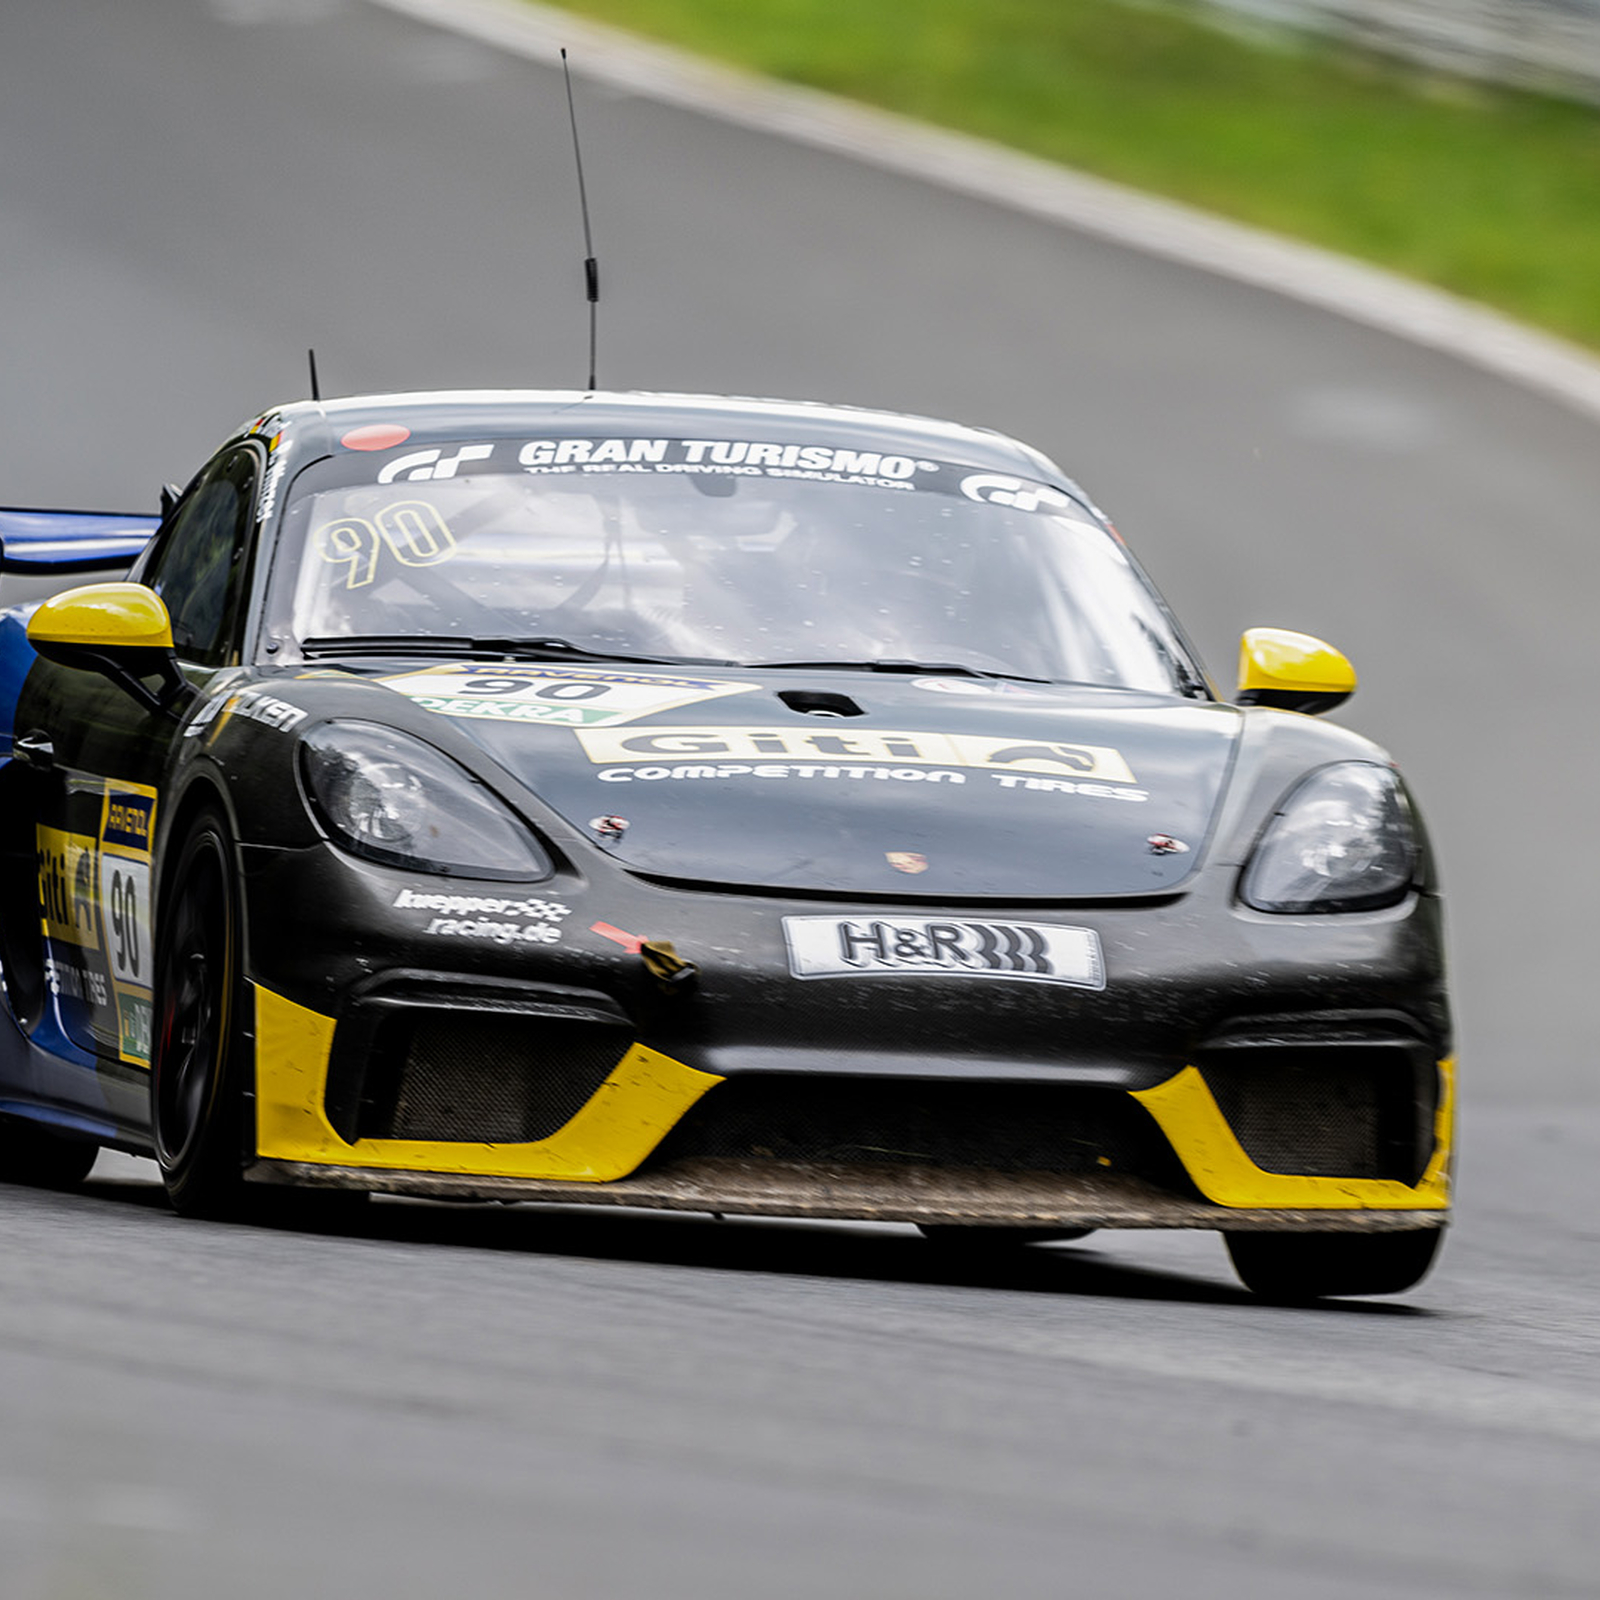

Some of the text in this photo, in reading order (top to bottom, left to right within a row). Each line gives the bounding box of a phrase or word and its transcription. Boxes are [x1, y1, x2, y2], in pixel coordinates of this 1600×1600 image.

[518, 439, 668, 466] GRAN
[523, 463, 916, 491] THE REAL DRIVING SIMULATOR
[312, 500, 457, 590] 90
[457, 678, 611, 700] 90
[410, 696, 584, 723] DEKRA
[620, 732, 922, 758] Giti
[597, 764, 1150, 802] COMPETITION TIRES
[111, 869, 140, 979] 90
[422, 916, 562, 945] racing.de
[837, 920, 972, 968] H&R
